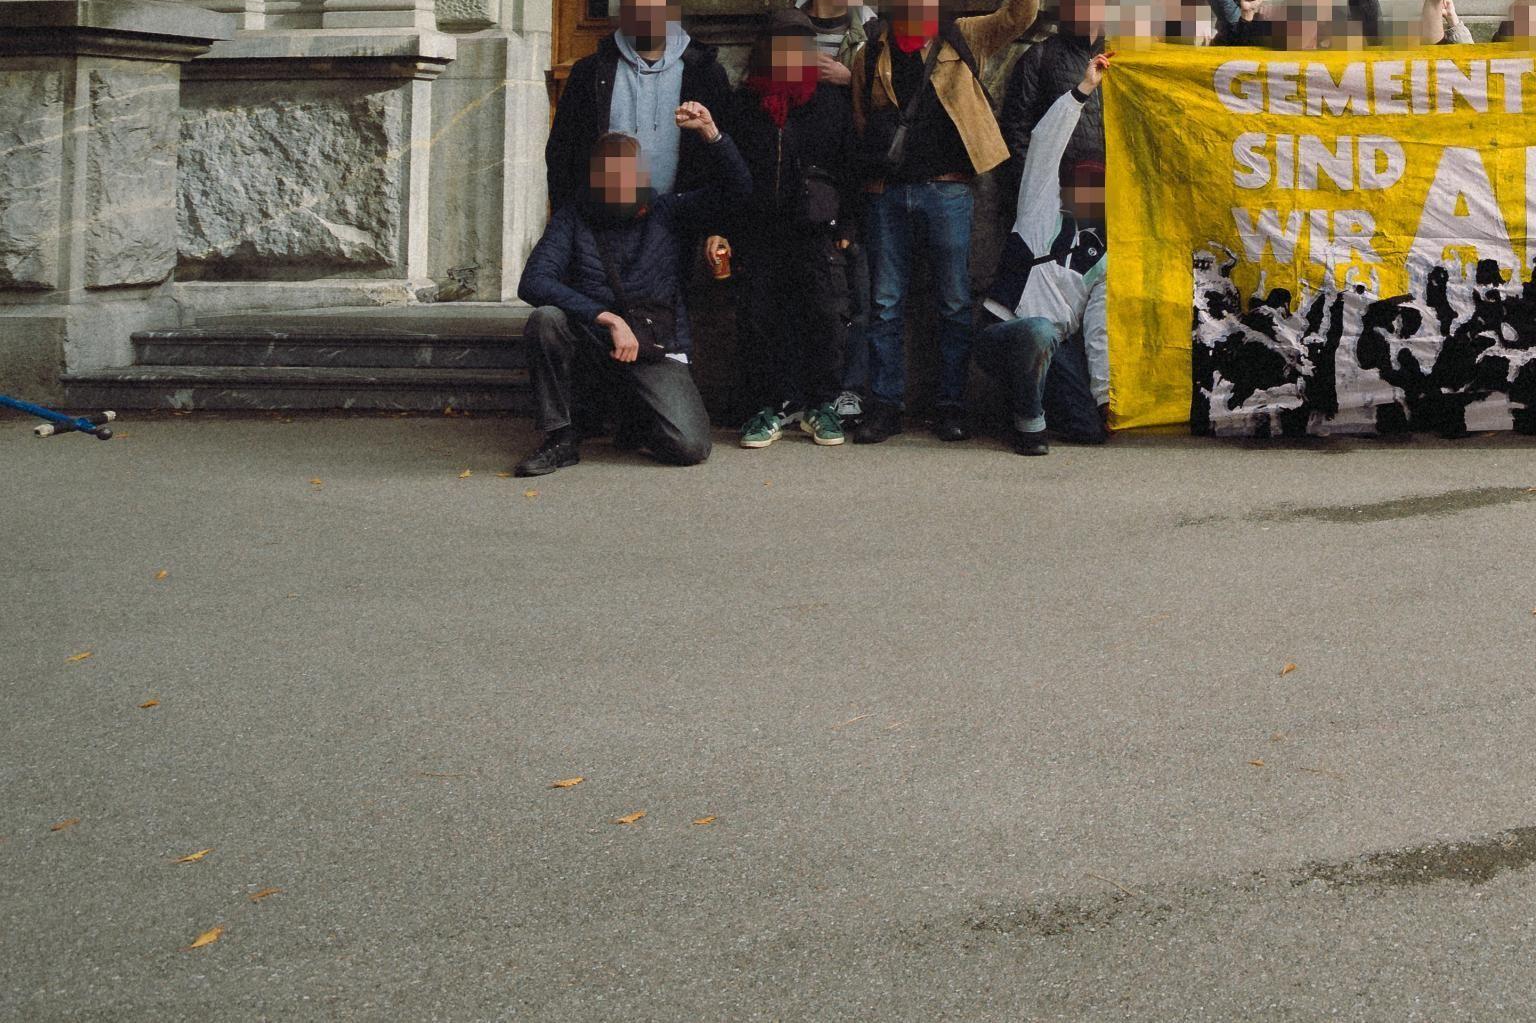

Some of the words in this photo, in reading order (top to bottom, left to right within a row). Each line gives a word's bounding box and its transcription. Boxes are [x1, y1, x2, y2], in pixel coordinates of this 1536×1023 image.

[1213, 58, 1534, 117] GEMEINT
[1231, 132, 1407, 191] SIND
[1231, 206, 1383, 265] WIR
